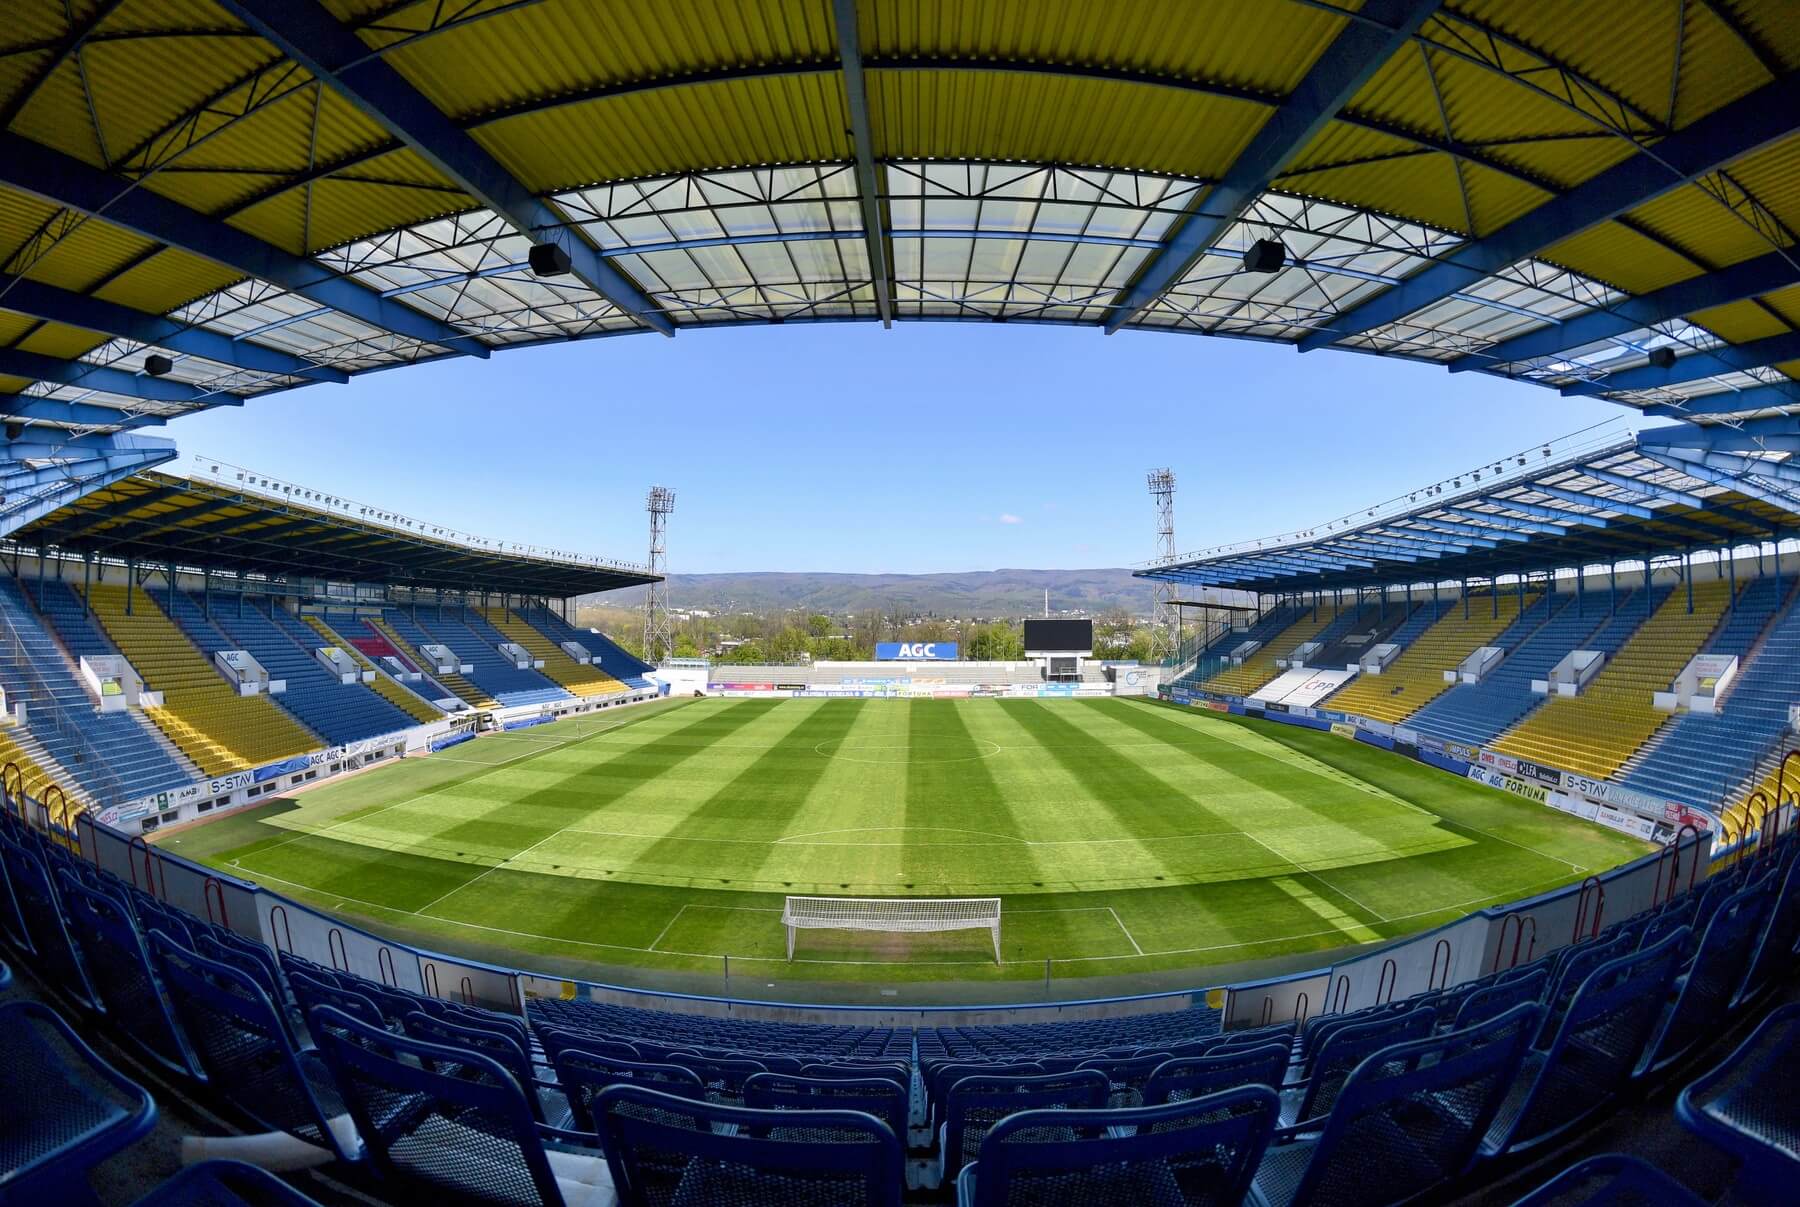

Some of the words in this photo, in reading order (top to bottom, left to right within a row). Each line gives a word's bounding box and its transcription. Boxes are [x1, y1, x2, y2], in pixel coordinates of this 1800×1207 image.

[226, 653, 239, 662] AGC
[899, 643, 936, 657] AGC
[310, 753, 324, 765] AGC
[326, 749, 339, 760] AGC
[211, 775, 251, 793] S-STAV
[1471, 768, 1486, 781] AGC
[1488, 775, 1504, 788] AGC
[1567, 776, 1608, 797] S-STAV
[1505, 780, 1545, 802] FORTUNA
